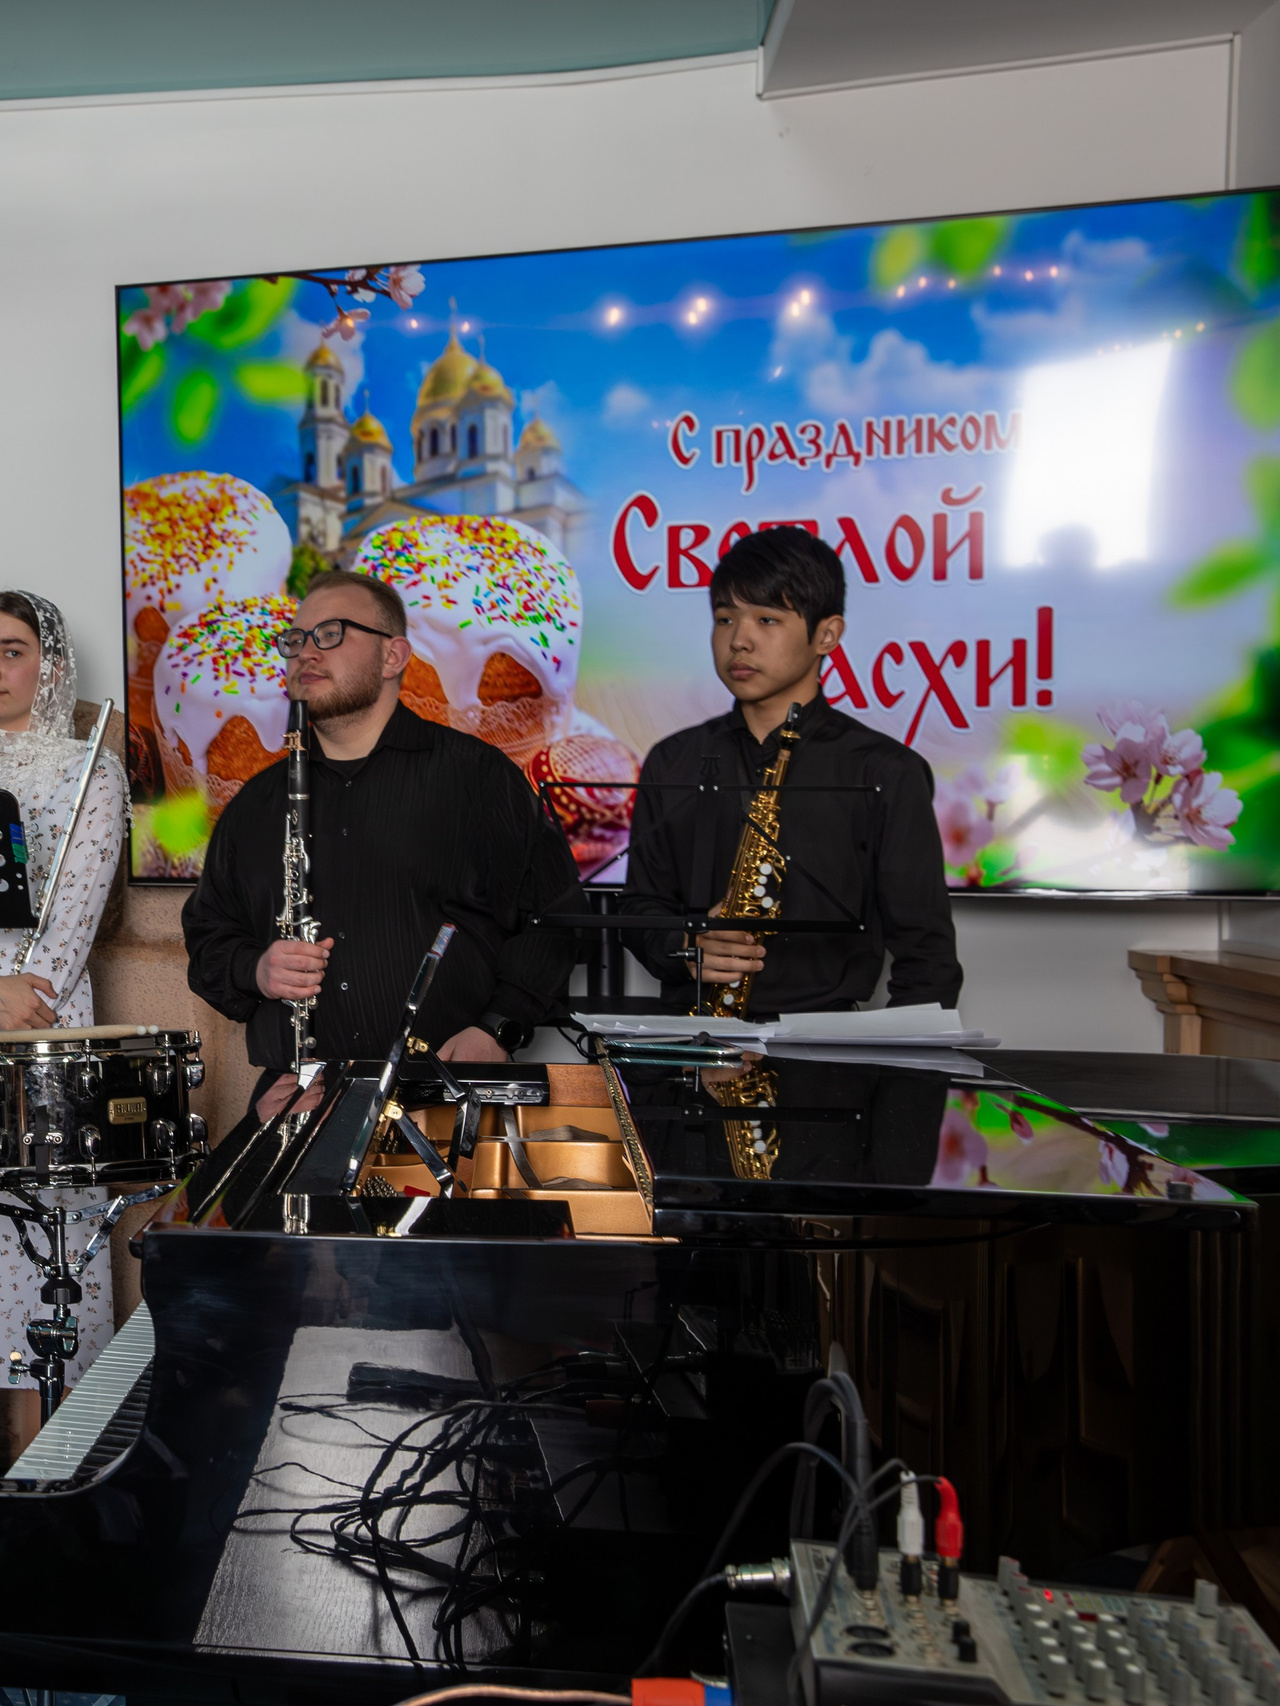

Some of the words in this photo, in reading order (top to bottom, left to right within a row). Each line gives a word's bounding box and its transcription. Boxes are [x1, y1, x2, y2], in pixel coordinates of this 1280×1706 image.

[671, 413, 700, 466] С
[714, 412, 1023, 492] праздником
[612, 486, 984, 591] Свлой
[818, 606, 1054, 748] асхи!
